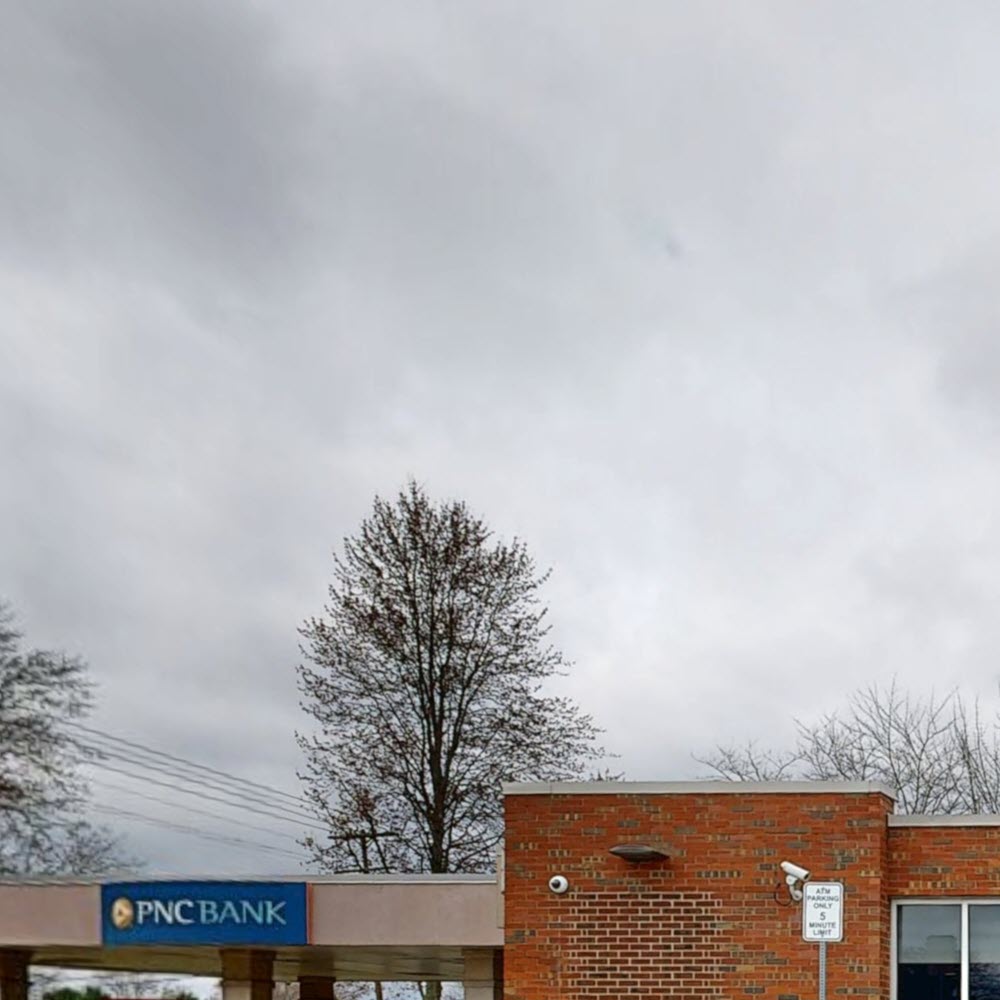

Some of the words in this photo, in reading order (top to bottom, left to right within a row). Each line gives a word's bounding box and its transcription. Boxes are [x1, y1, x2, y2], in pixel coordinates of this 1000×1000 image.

[126, 900, 195, 925] PNC
[196, 900, 287, 925] BANK
[820, 911, 826, 921] 5
